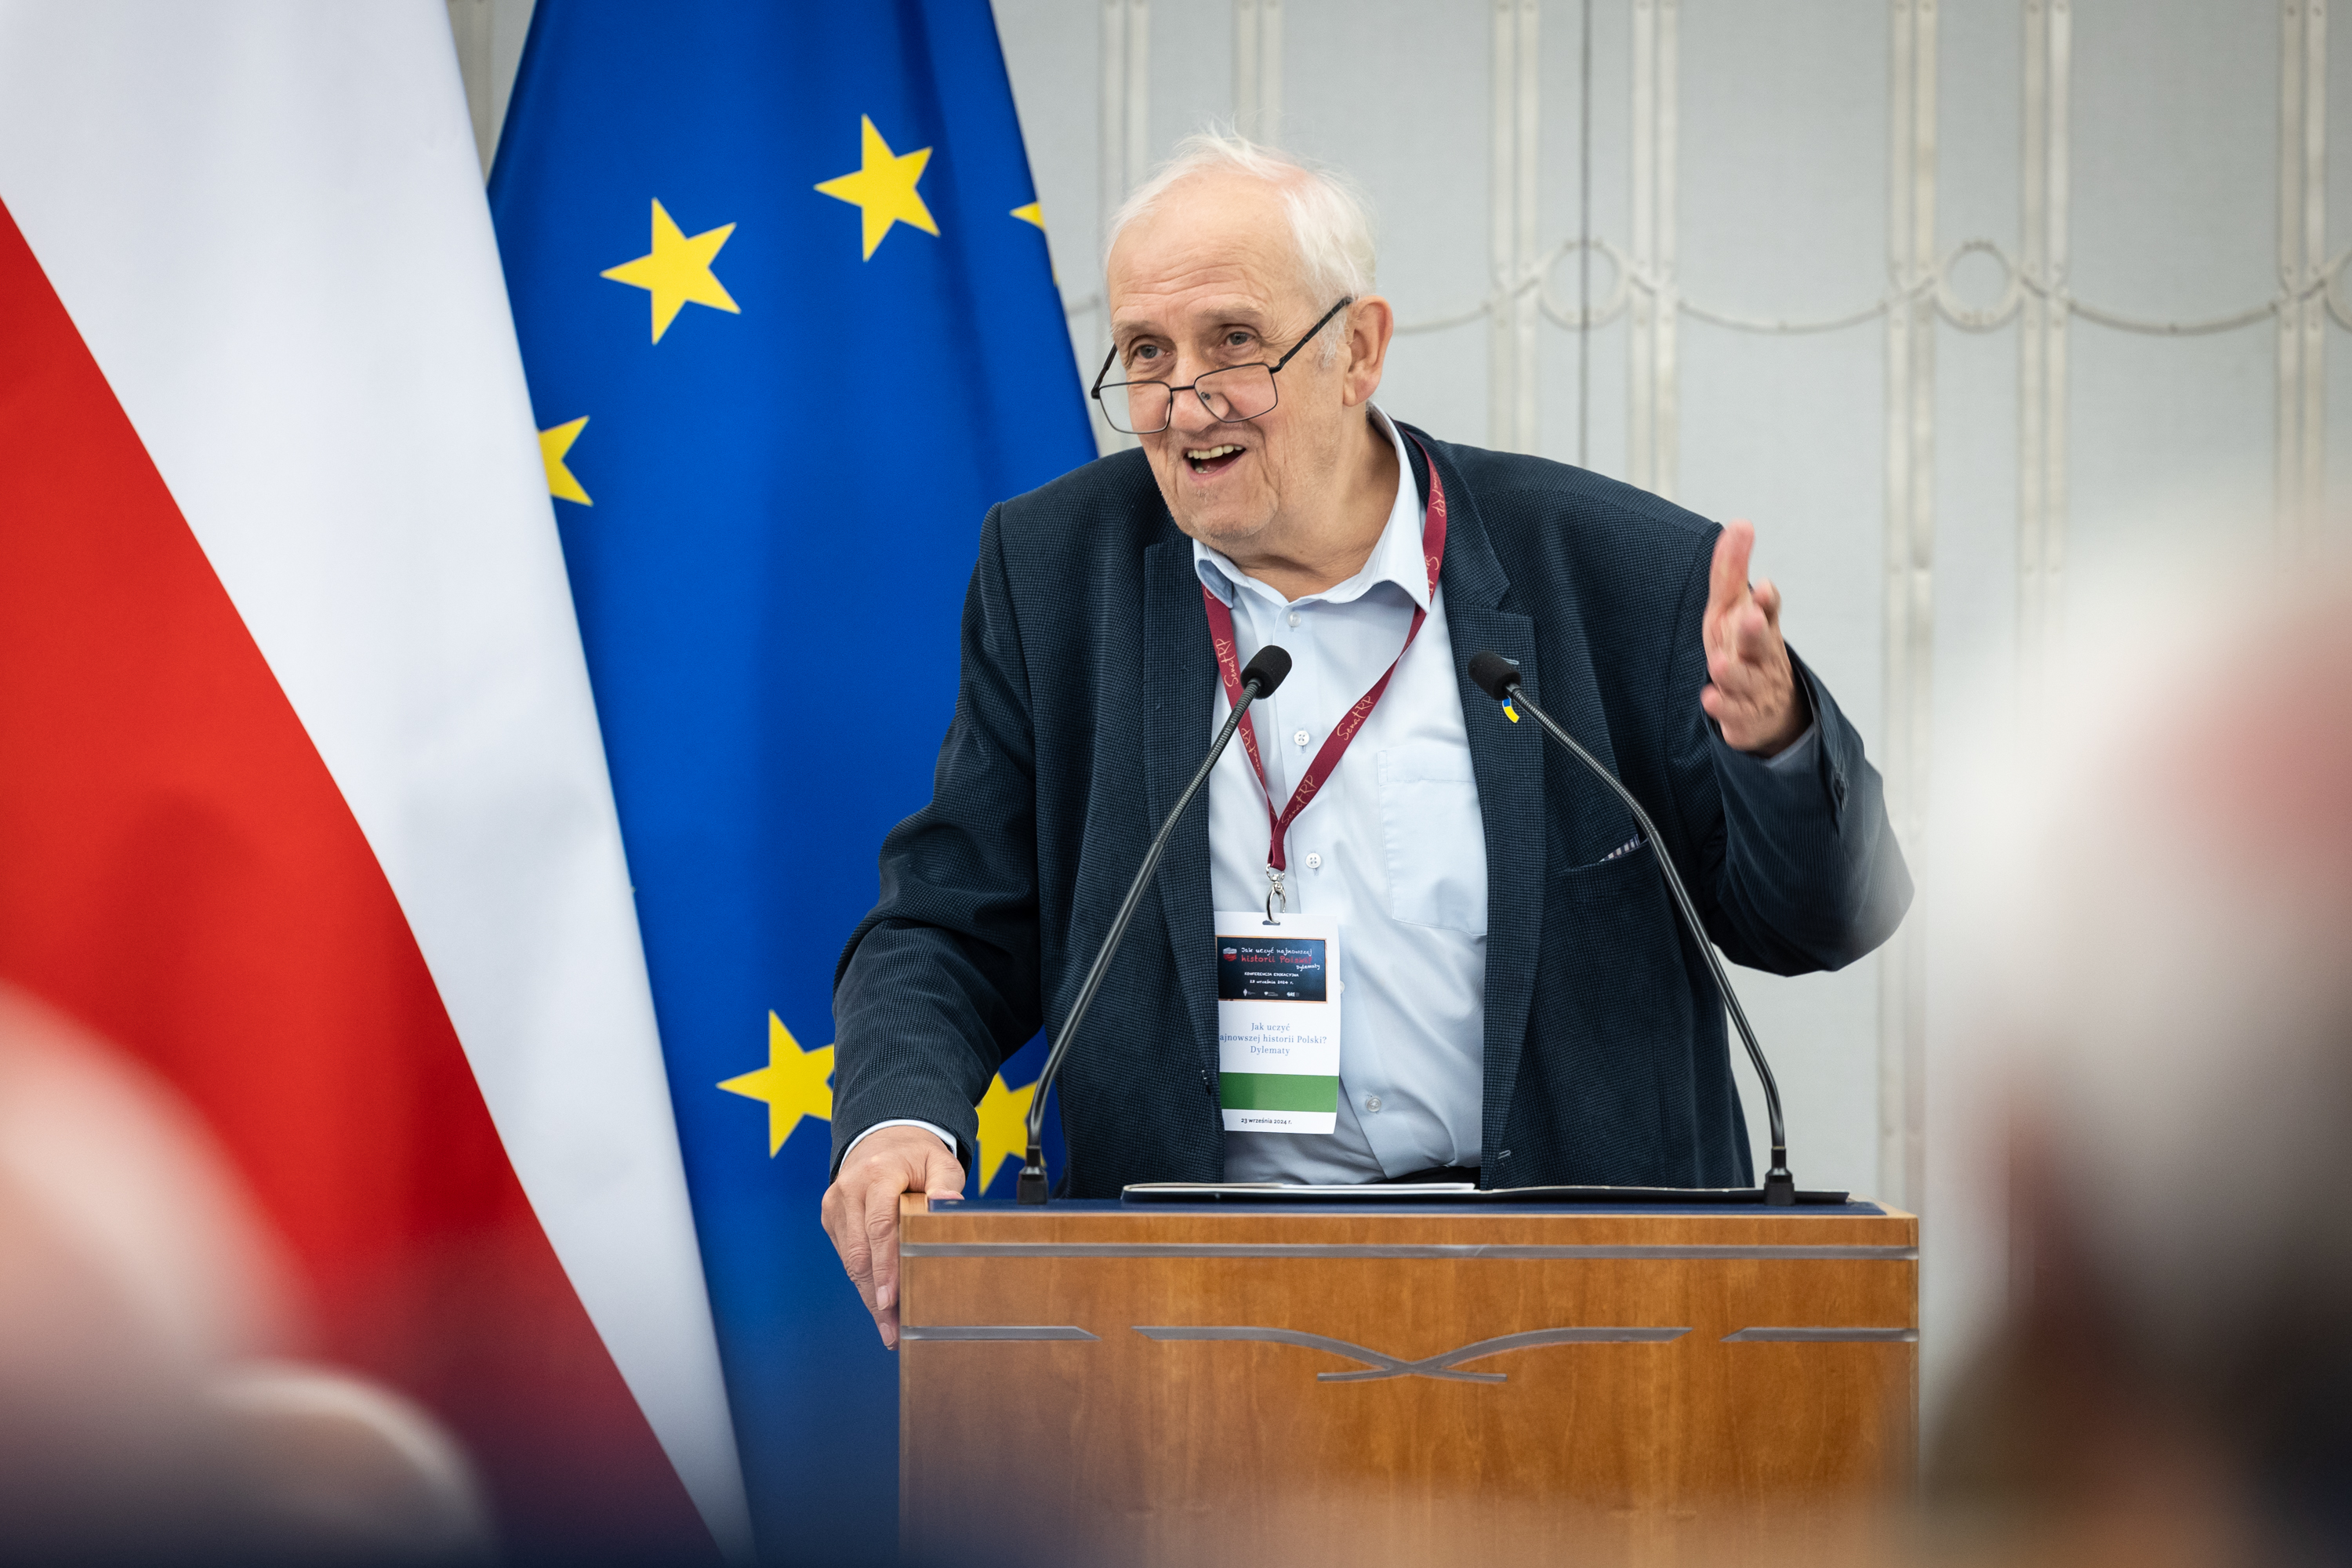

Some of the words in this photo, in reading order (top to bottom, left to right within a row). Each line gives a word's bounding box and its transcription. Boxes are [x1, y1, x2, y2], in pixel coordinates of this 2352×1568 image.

[1255, 946, 1274, 956] uczyć
[1276, 947, 1312, 956] najnowszej
[1241, 954, 1276, 964] historii
[1279, 956, 1312, 965] Polski?
[1296, 963, 1320, 972] Dylematy
[1250, 1022, 1264, 1032] Jak
[1267, 1023, 1290, 1033] uczyć
[1219, 1033, 1261, 1044] ajnowszej
[1263, 1034, 1294, 1044] historii
[1297, 1035, 1327, 1044] Polski?
[1250, 1045, 1290, 1057] Dylematy
